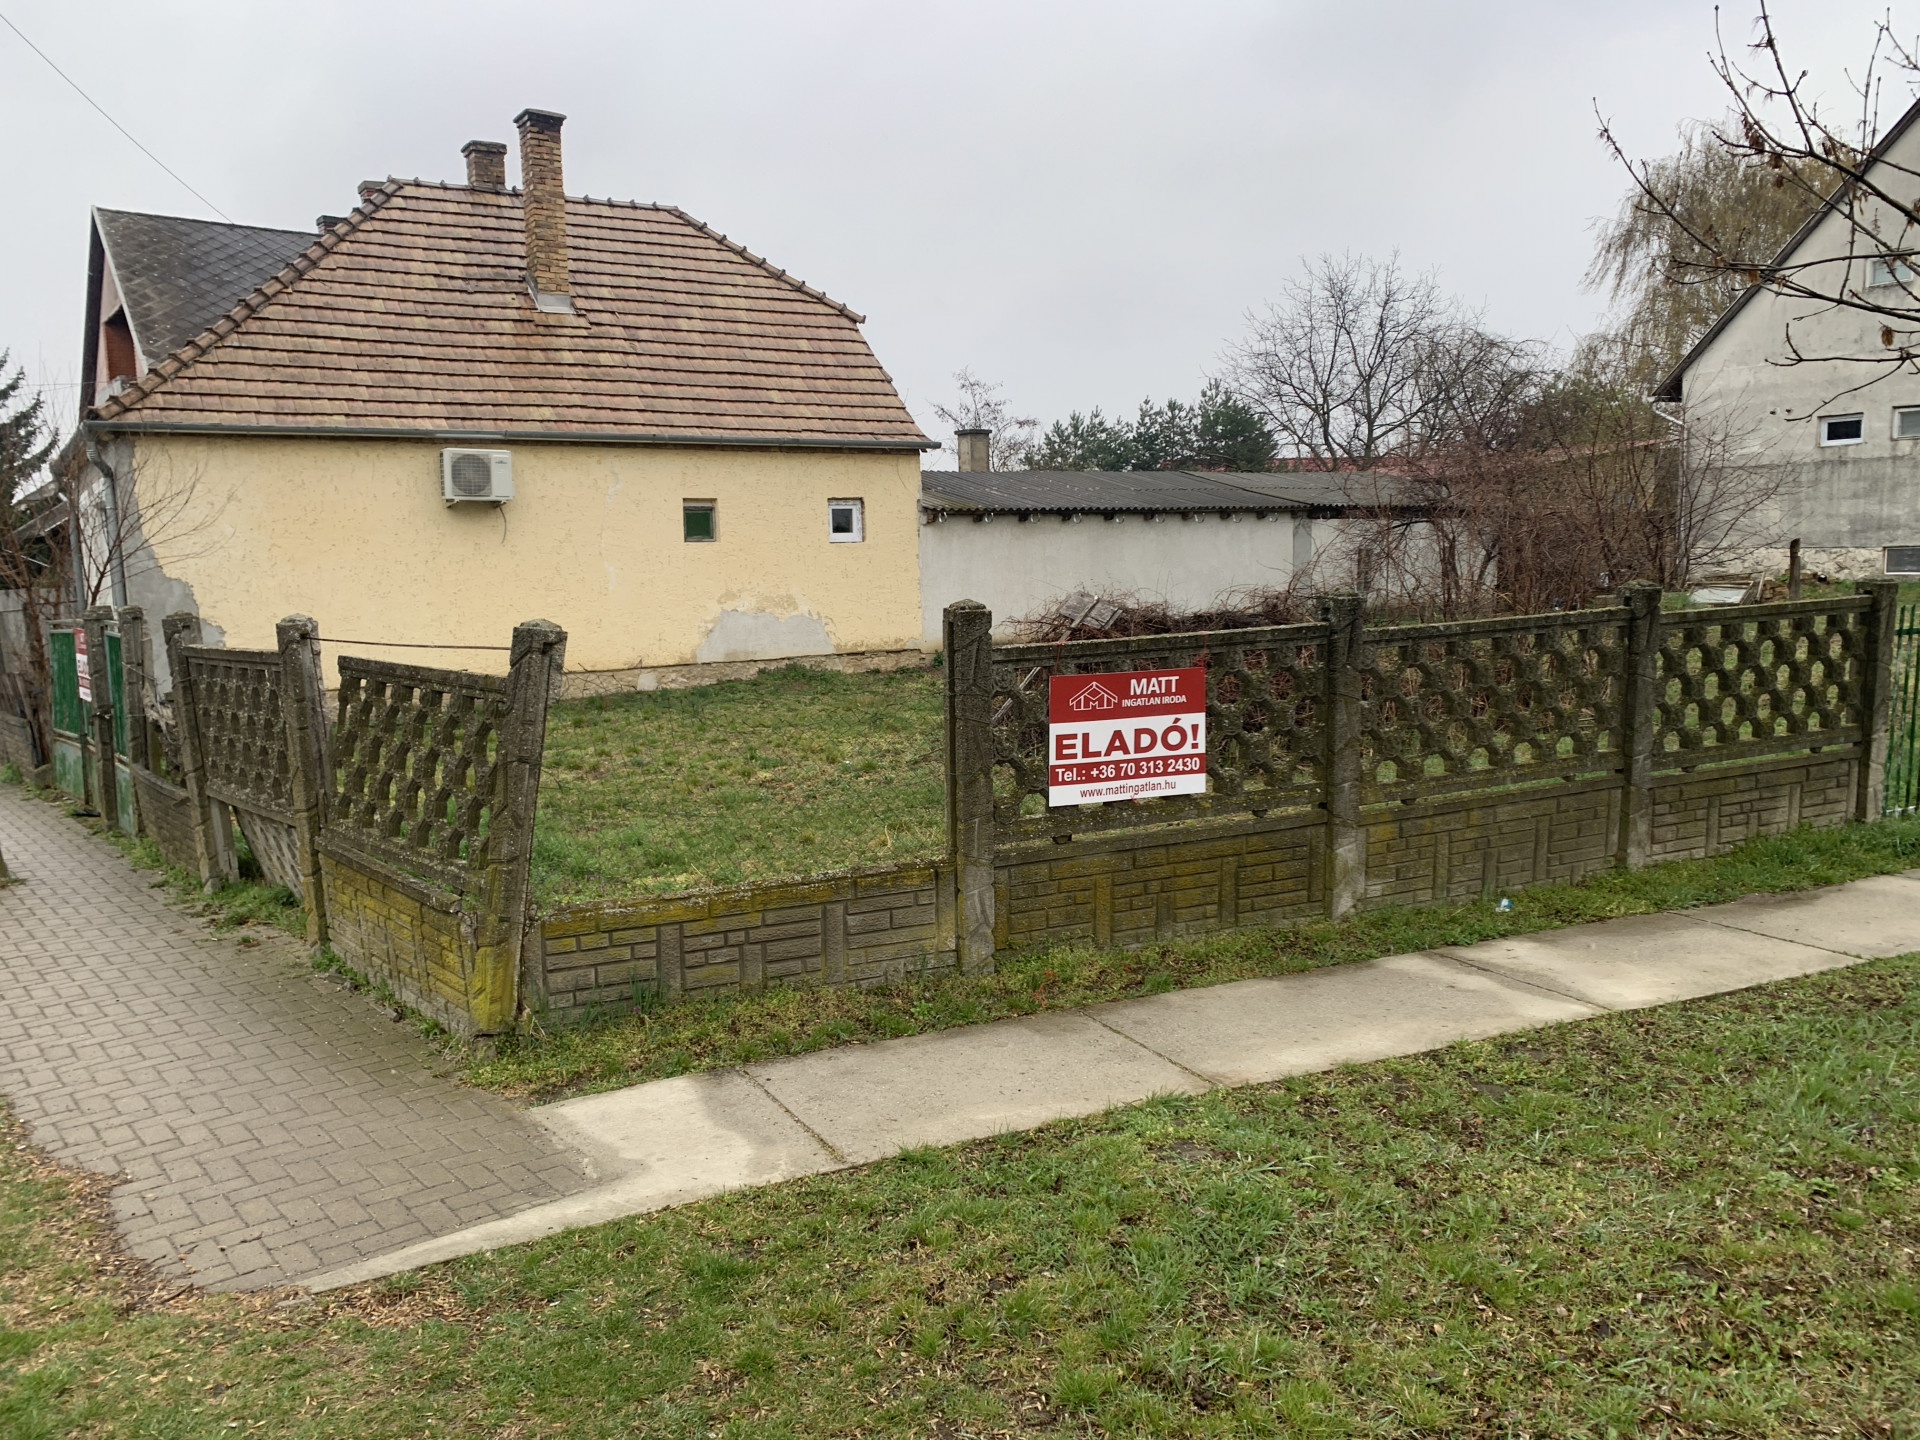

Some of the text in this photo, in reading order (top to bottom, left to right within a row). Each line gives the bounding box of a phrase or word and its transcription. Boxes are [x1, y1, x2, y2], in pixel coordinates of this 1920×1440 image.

[1130, 676, 1180, 695] MATT
[1122, 695, 1187, 707] INGATLAN IRODA
[1055, 717, 1199, 760] ELADÓ!
[1055, 757, 1200, 782] Tel.: +36 70 313 2430
[1080, 779, 1176, 798] www.mattingatlan.hu
